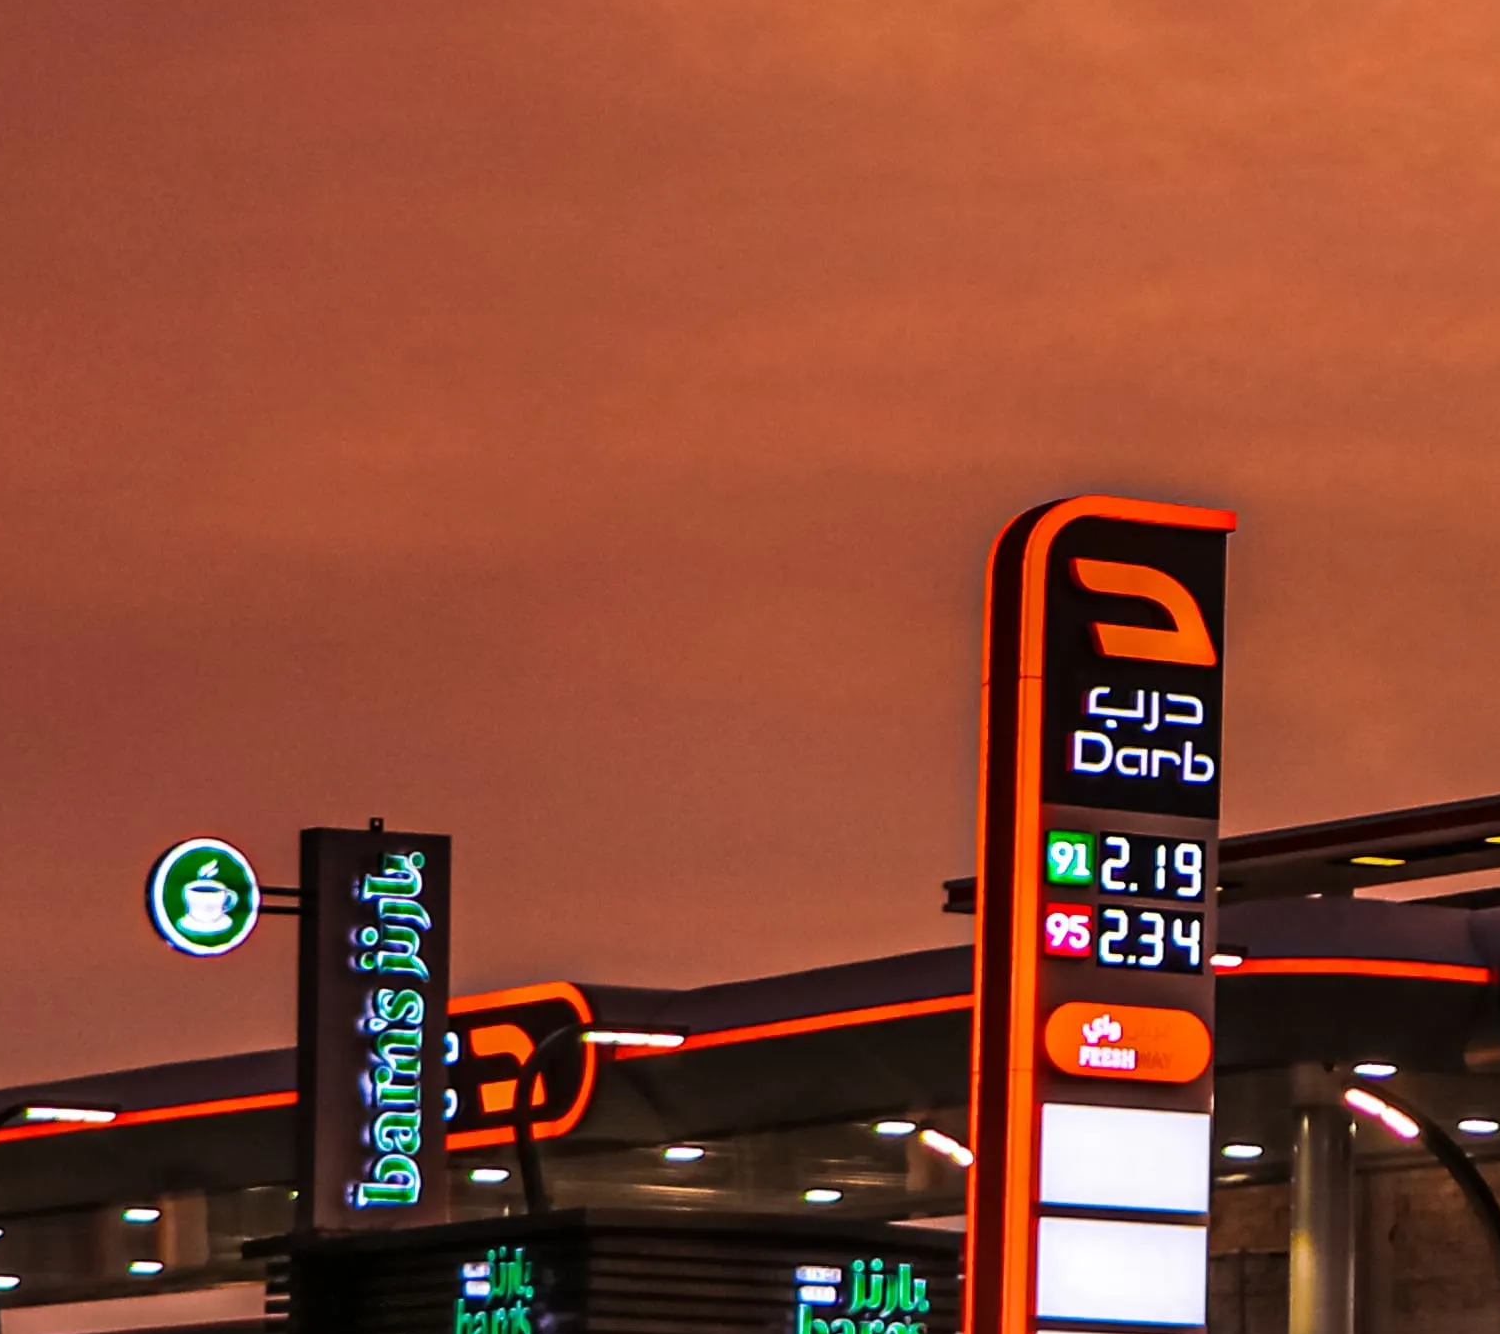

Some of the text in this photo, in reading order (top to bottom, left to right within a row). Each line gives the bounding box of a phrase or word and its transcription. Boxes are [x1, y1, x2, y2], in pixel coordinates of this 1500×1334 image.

[1086, 686, 1204, 731] درب
[1072, 730, 1215, 783] Darb
[1050, 836, 1203, 897] 91 2.19
[1045, 908, 1201, 966] 95 2.34
[1079, 1045, 1136, 1070] FRESH
